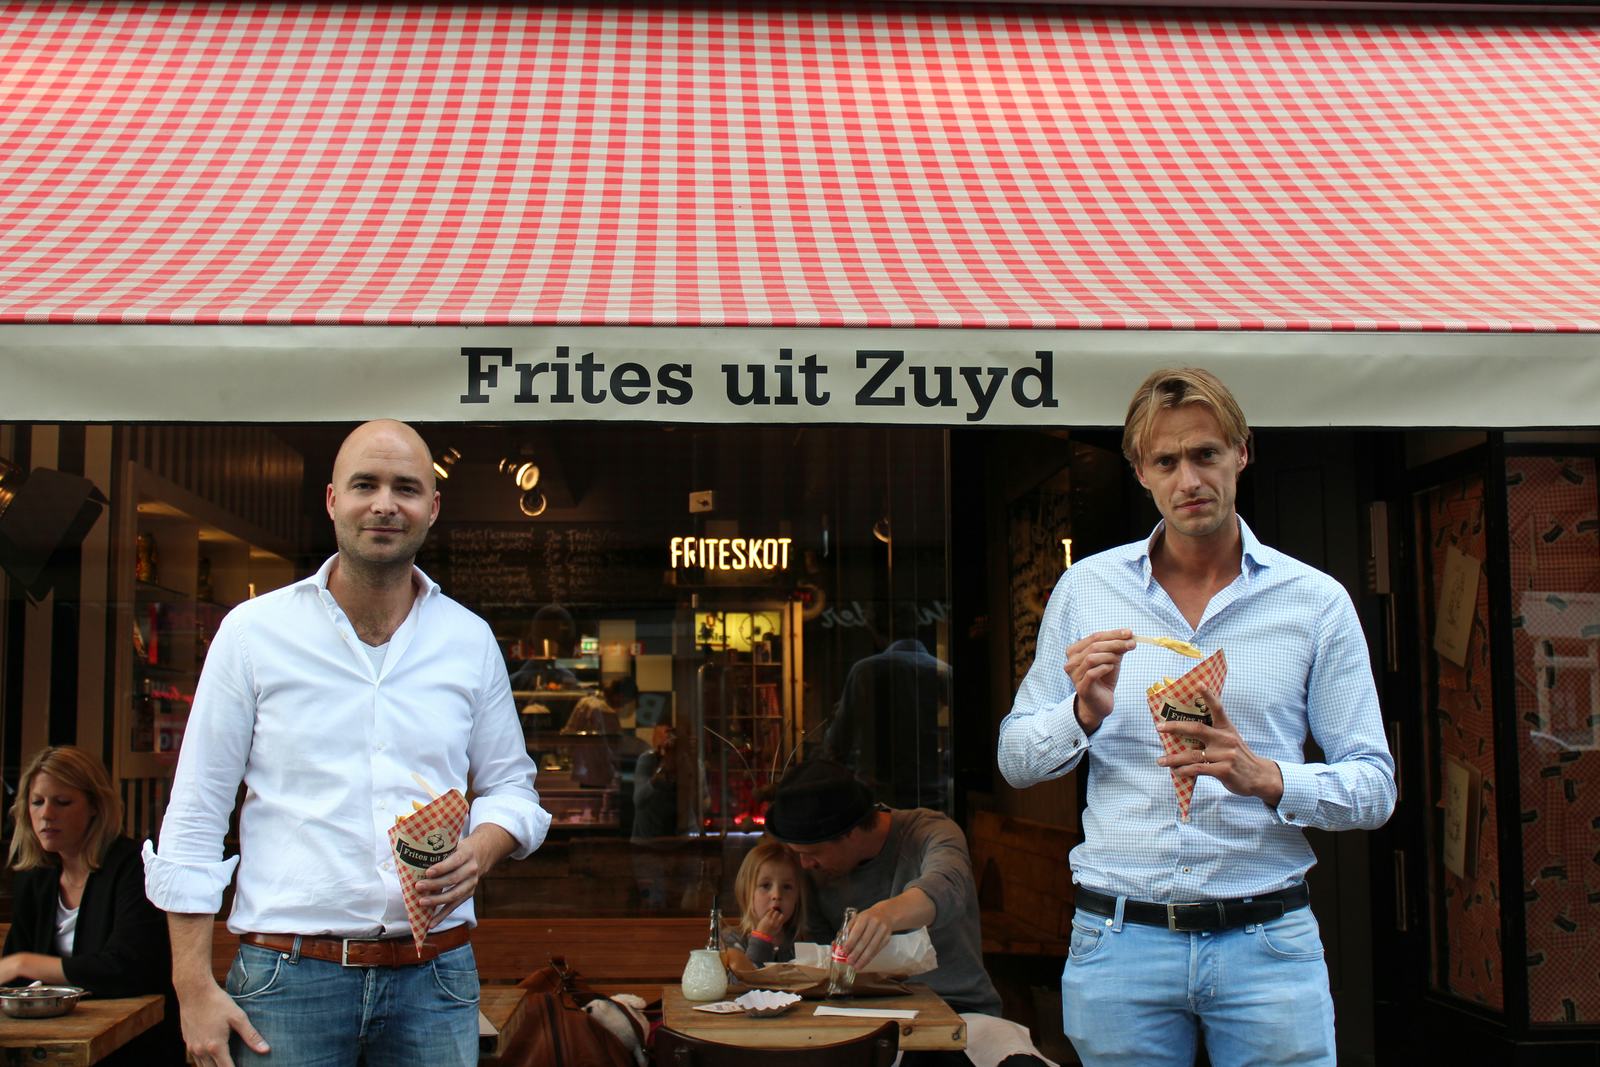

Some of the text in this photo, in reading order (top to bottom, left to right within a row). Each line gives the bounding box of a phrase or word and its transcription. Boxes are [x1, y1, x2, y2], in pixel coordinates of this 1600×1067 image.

[461, 346, 1058, 422] Frites uit Zuyd
[670, 536, 793, 571] FRITESKOT
[404, 848, 428, 861] Frites
